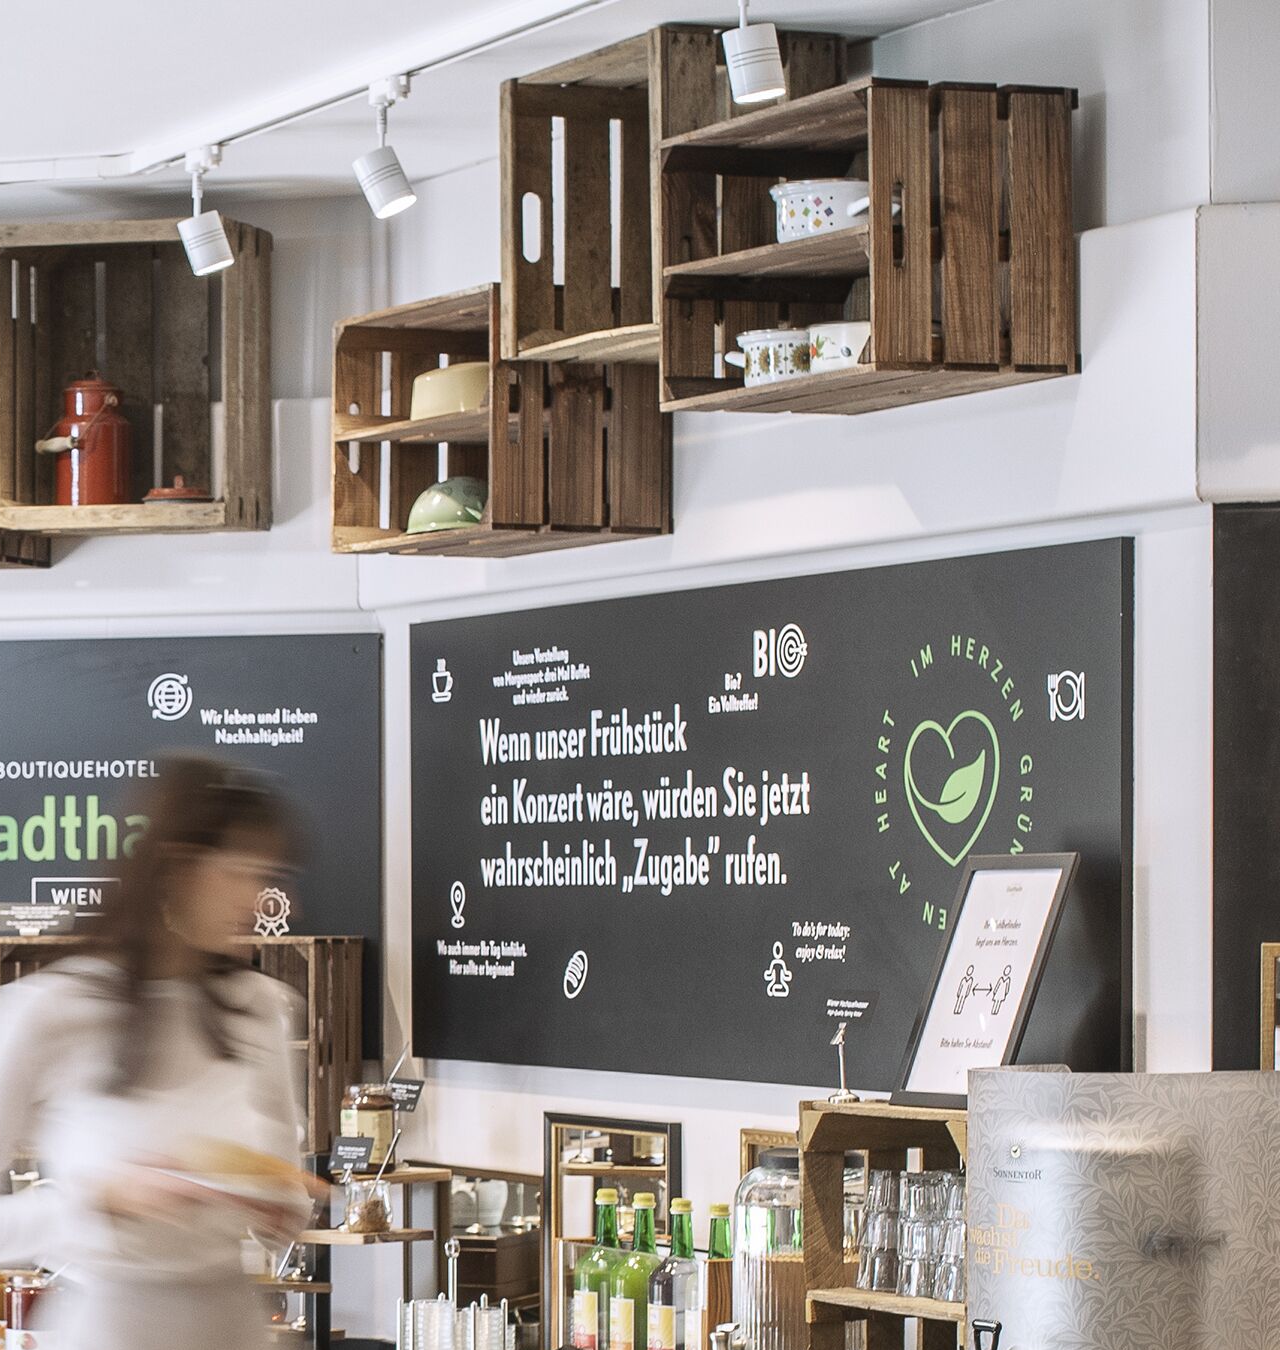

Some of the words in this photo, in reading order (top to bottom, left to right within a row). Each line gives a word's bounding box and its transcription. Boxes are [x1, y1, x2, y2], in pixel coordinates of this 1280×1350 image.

[725, 672, 742, 691] Bio?
[911, 644, 933, 678] IM
[951, 635, 1024, 722] HERZEN
[708, 695, 720, 713] Ein
[200, 708, 223, 725] Wir
[224, 708, 256, 725] leben
[257, 707, 280, 724] und
[282, 707, 318, 724] lieben
[215, 727, 304, 746] Nachhaltigkeit!
[480, 717, 531, 766] Wenn
[535, 728, 586, 761] unser
[591, 703, 687, 757] Frühstück
[875, 709, 896, 832] HEART
[480, 784, 508, 826] ein
[513, 778, 584, 824] Konzert
[587, 779, 639, 827] wäre,
[642, 769, 718, 820] würden
[722, 766, 757, 817] Sie
[760, 769, 810, 826] jetzt
[480, 838, 617, 887] wahrscheinlich
[724, 834, 788, 885] rufen.
[889, 860, 911, 894] AT
[50, 888, 102, 906] WIEN
[792, 921, 802, 937] To
[814, 922, 828, 940] for
[795, 944, 816, 963] enjoy
[996, 1202, 1031, 1230] Da
